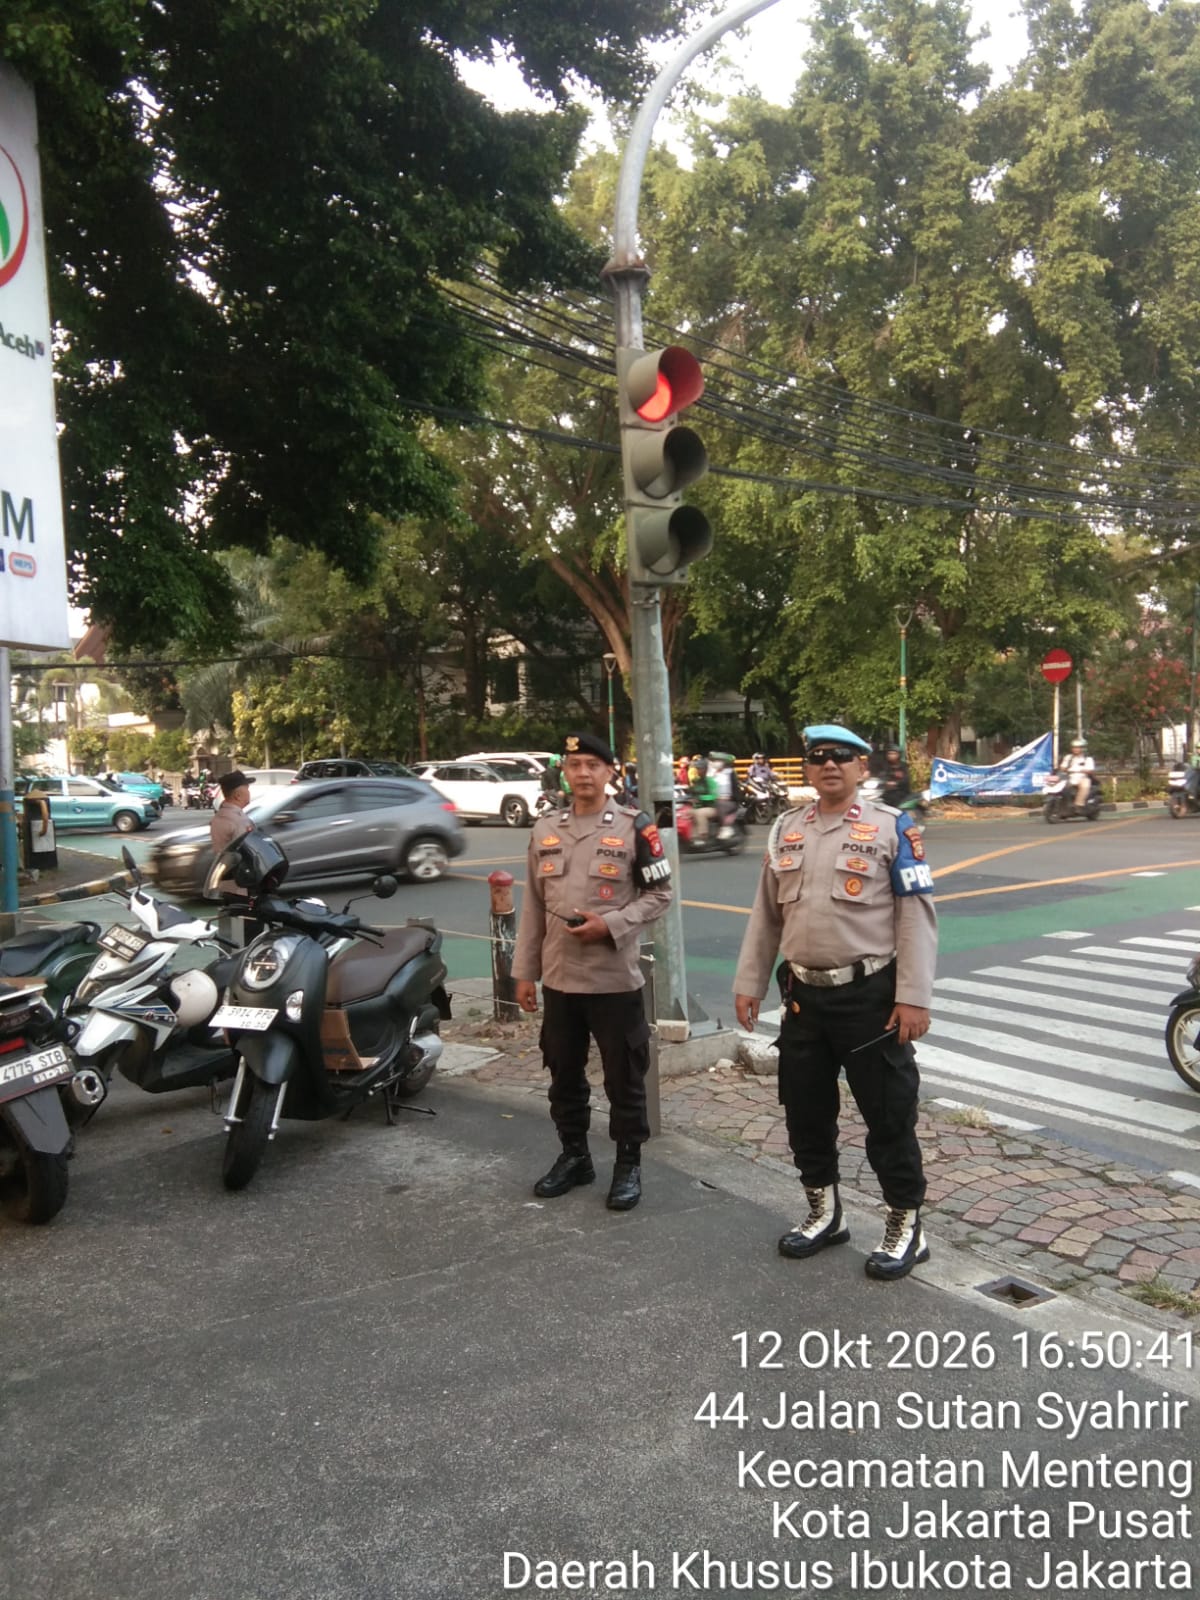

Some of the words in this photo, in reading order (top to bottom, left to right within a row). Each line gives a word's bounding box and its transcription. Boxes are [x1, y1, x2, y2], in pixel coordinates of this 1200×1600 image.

[596, 848, 628, 859] POLRI
[842, 843, 878, 856] POLRI
[900, 864, 934, 891] PR
[3, 1060, 34, 1081] 4775
[38, 1050, 63, 1068] STB
